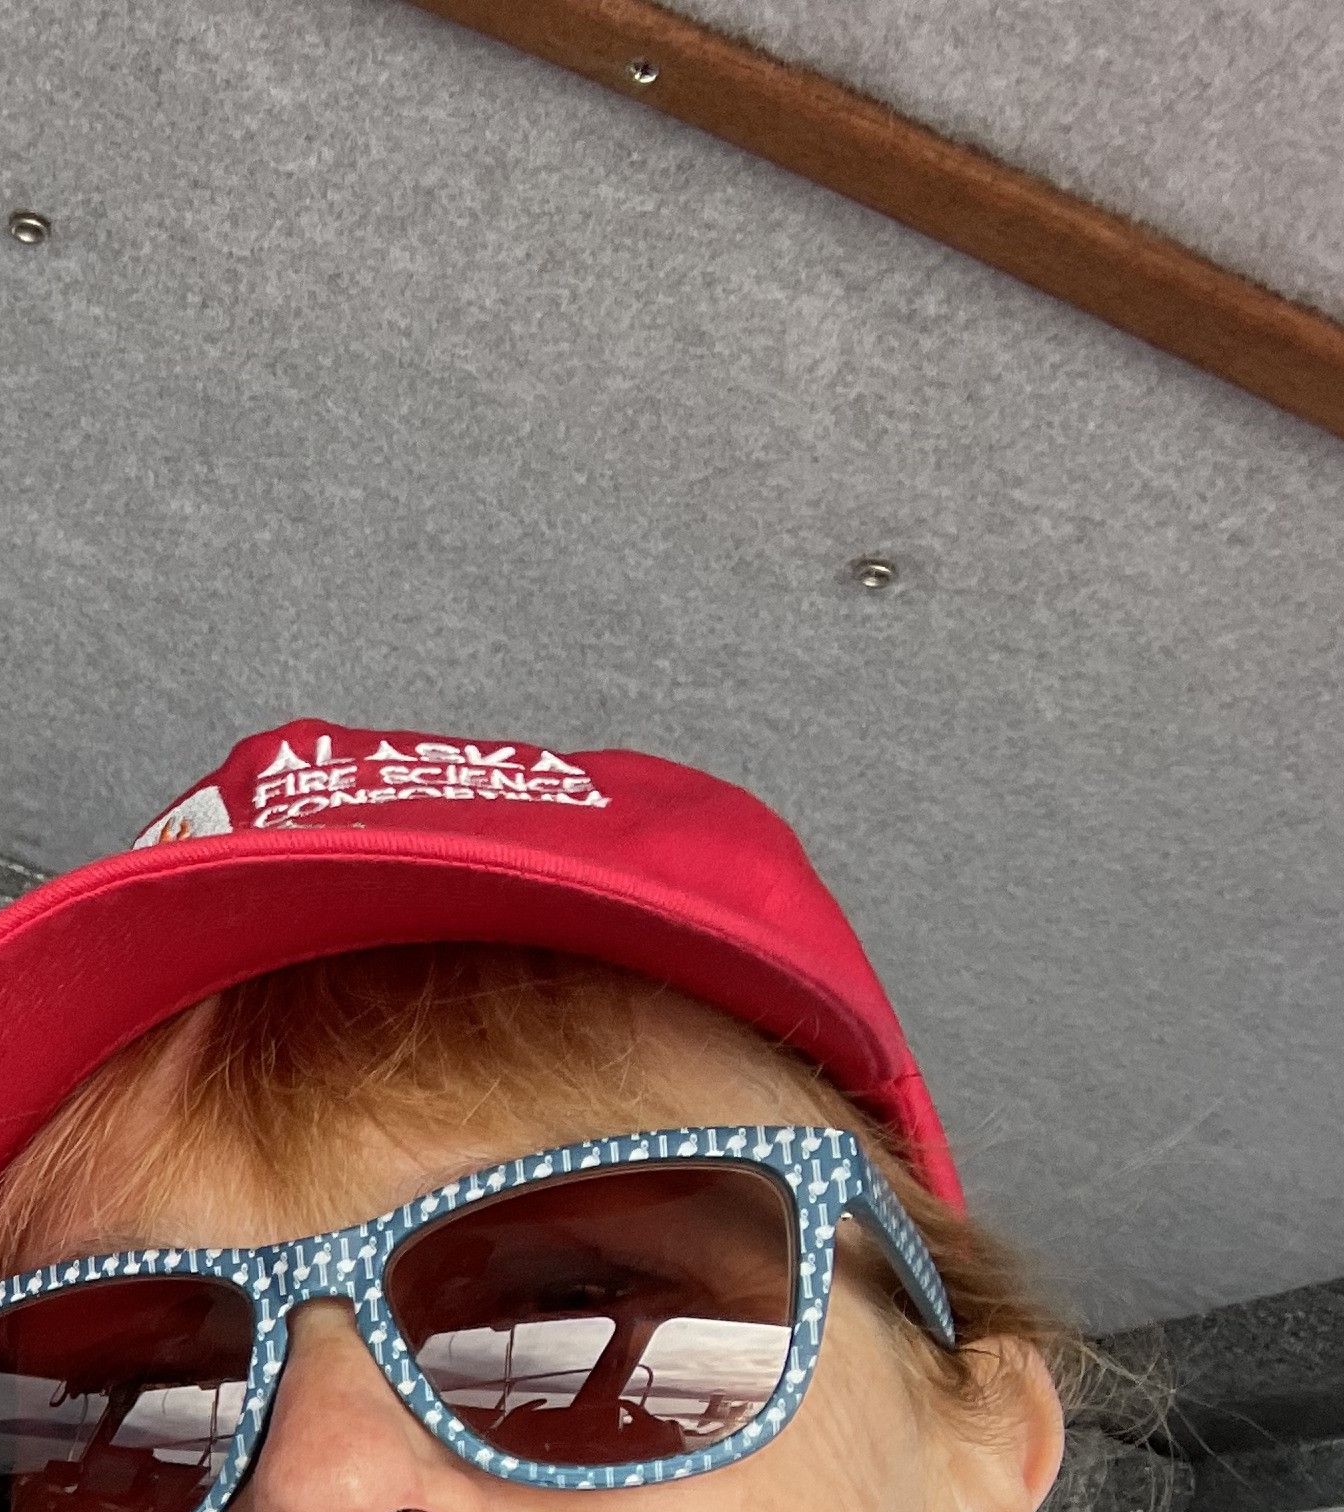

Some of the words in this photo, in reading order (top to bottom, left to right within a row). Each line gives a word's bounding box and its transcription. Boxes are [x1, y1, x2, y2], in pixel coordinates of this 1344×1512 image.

[257, 735, 586, 780] ALASKA
[252, 765, 359, 809] FIRE
[378, 763, 598, 795] SCIENCE
[252, 786, 613, 829] CONSORM
